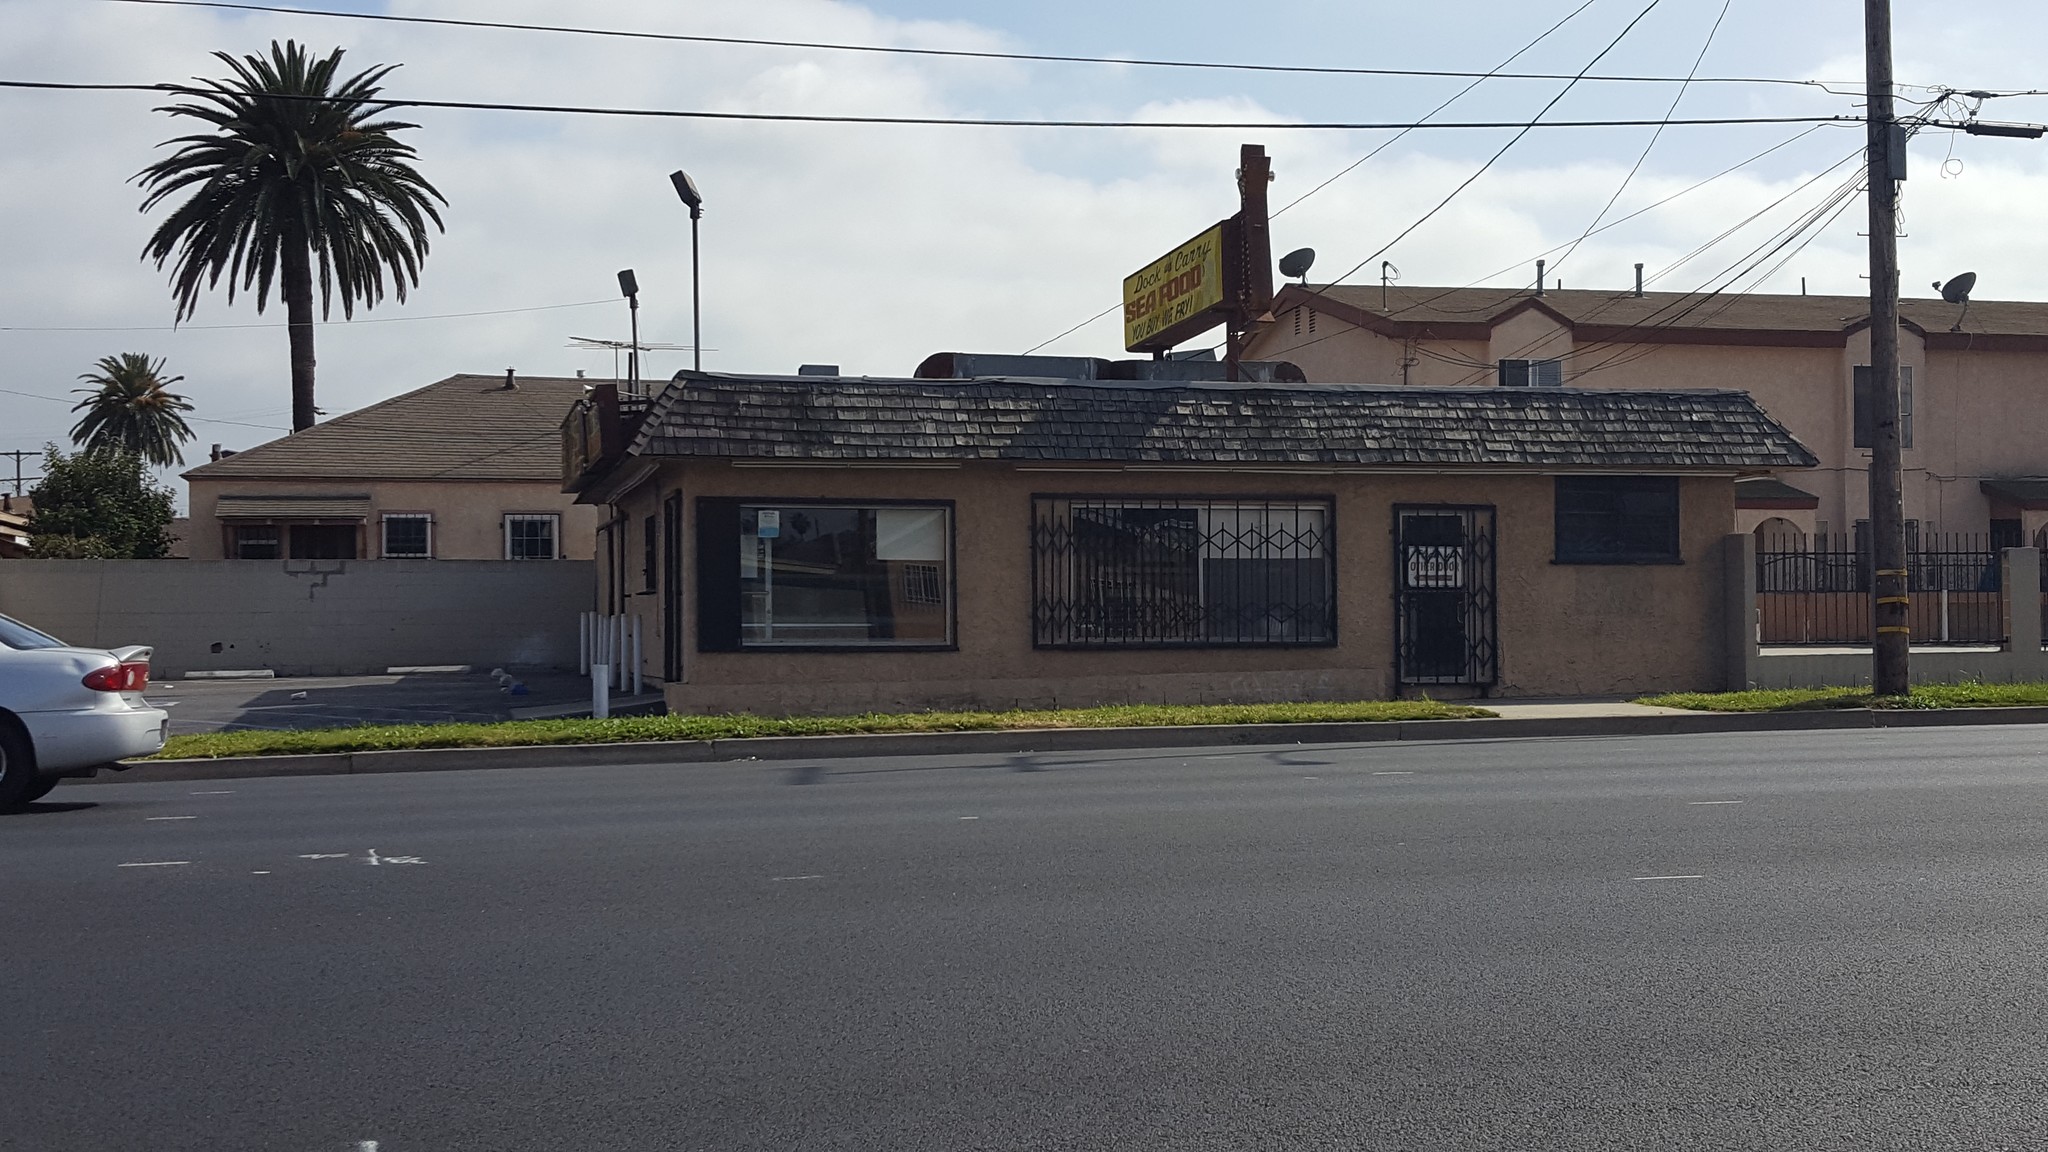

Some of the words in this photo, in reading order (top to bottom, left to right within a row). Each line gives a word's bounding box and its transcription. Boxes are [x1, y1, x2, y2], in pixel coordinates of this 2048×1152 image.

[1134, 265, 1161, 294] Dock
[1175, 240, 1211, 272] Carry
[1132, 320, 1146, 342] YOU
[1162, 307, 1173, 327] WE
[1410, 562, 1435, 571] OHR
